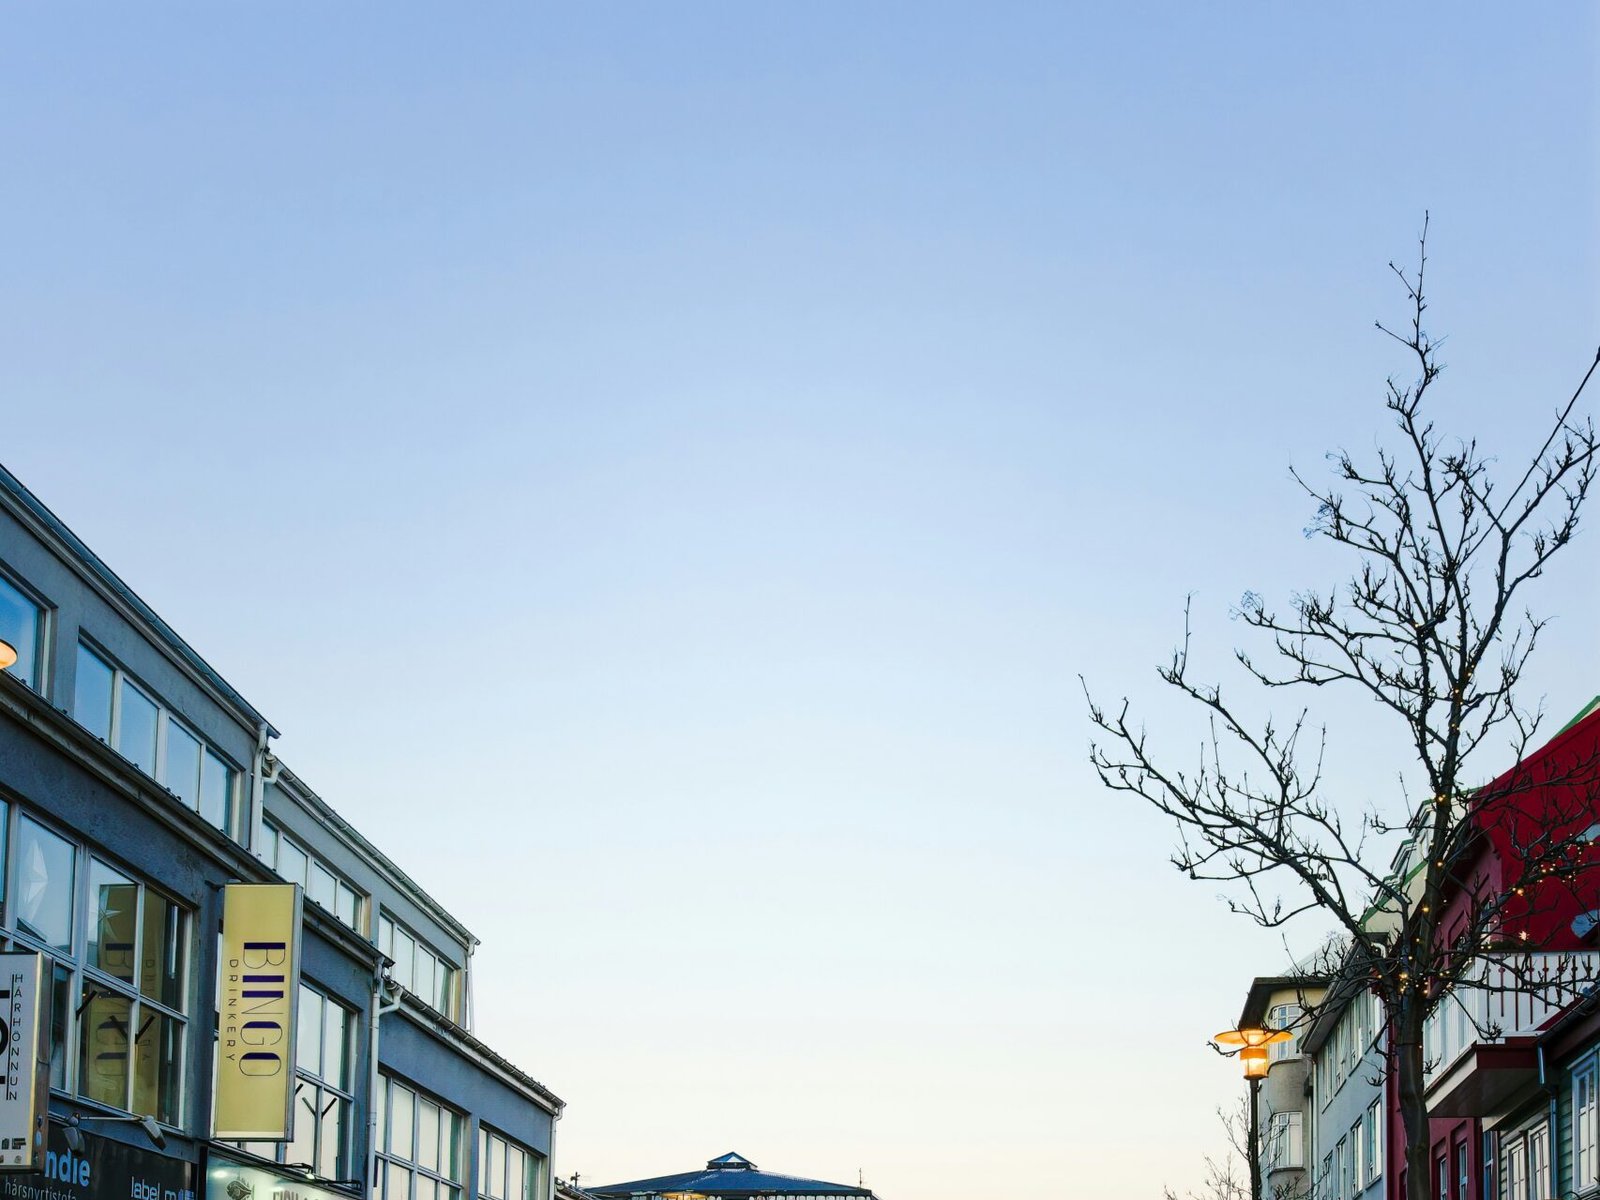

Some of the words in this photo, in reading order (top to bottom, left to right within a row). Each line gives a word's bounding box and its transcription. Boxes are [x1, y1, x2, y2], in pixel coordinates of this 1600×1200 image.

[9, 974, 23, 1100] HÁRHÖNNUN
[226, 959, 239, 1062] DRINKERY
[238, 942, 286, 1077] BINGO
